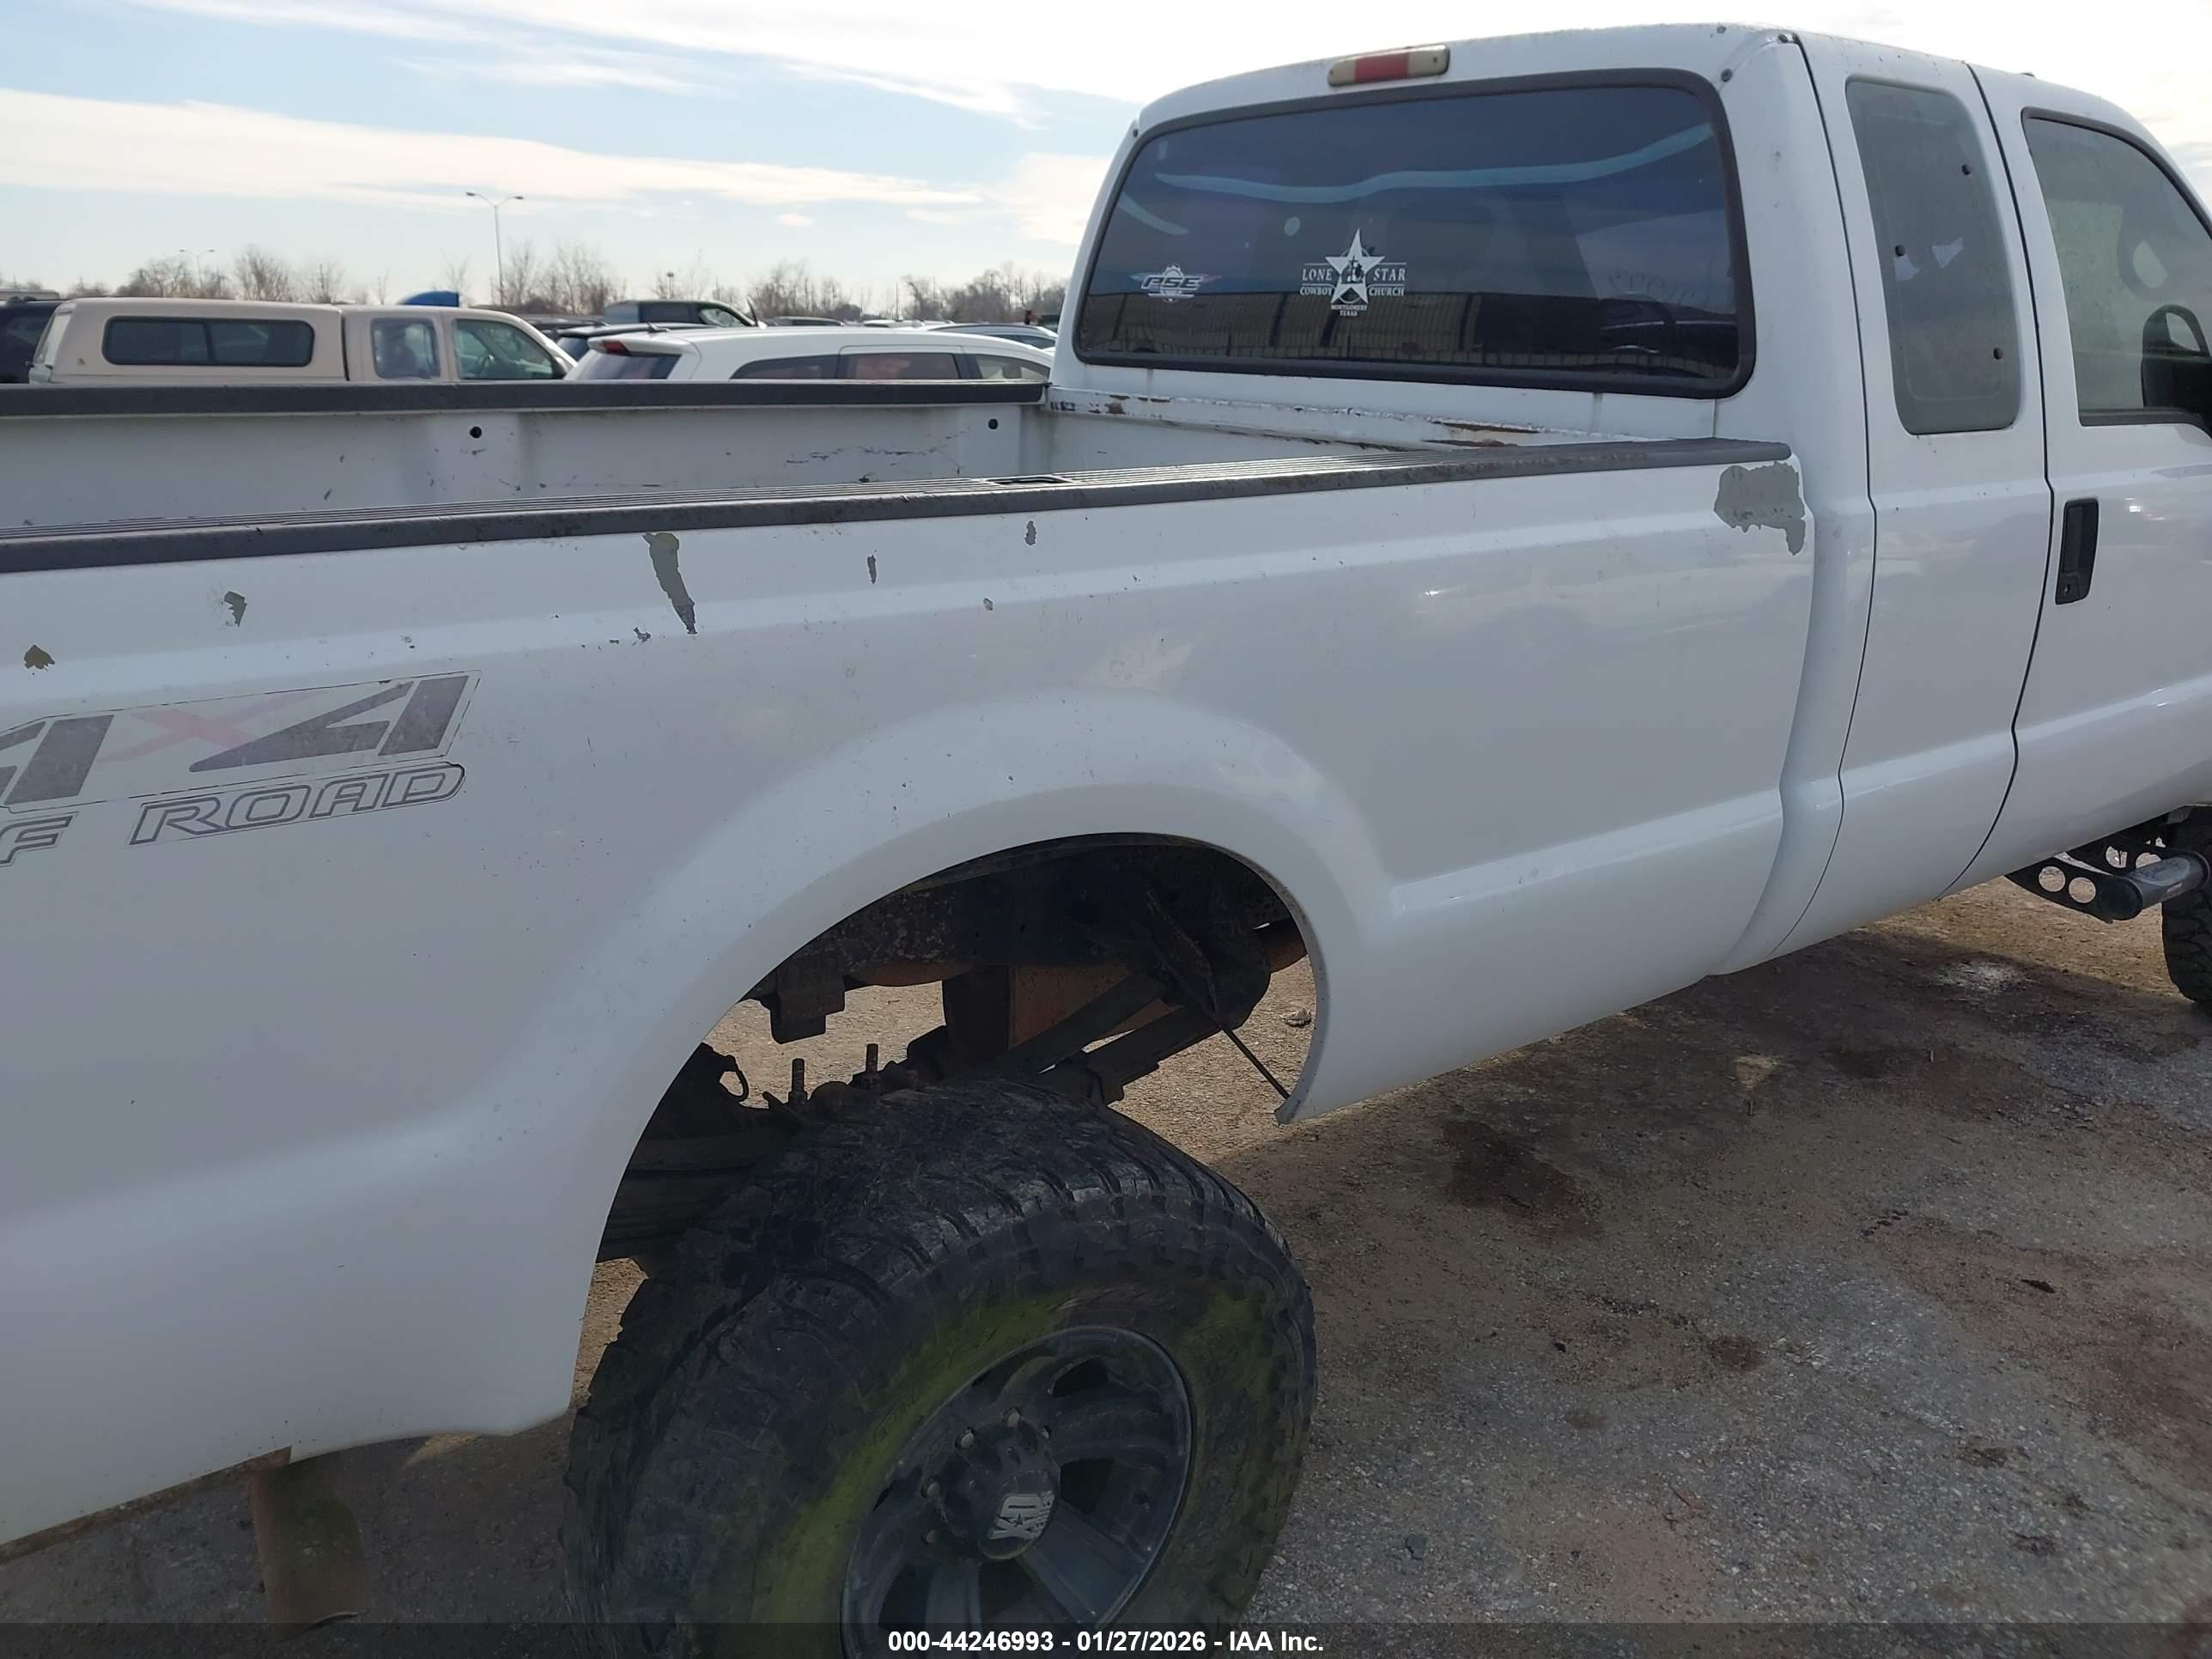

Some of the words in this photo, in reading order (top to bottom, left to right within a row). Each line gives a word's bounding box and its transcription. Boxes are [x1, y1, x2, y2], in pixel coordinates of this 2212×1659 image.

[1302, 268, 1333, 281] LONE
[1374, 268, 1406, 281] STAR
[1140, 275, 1204, 291] PSE
[1299, 287, 1332, 295] COWBOY
[1368, 287, 1405, 296] CHURCH
[129, 763, 465, 846] ROAD
